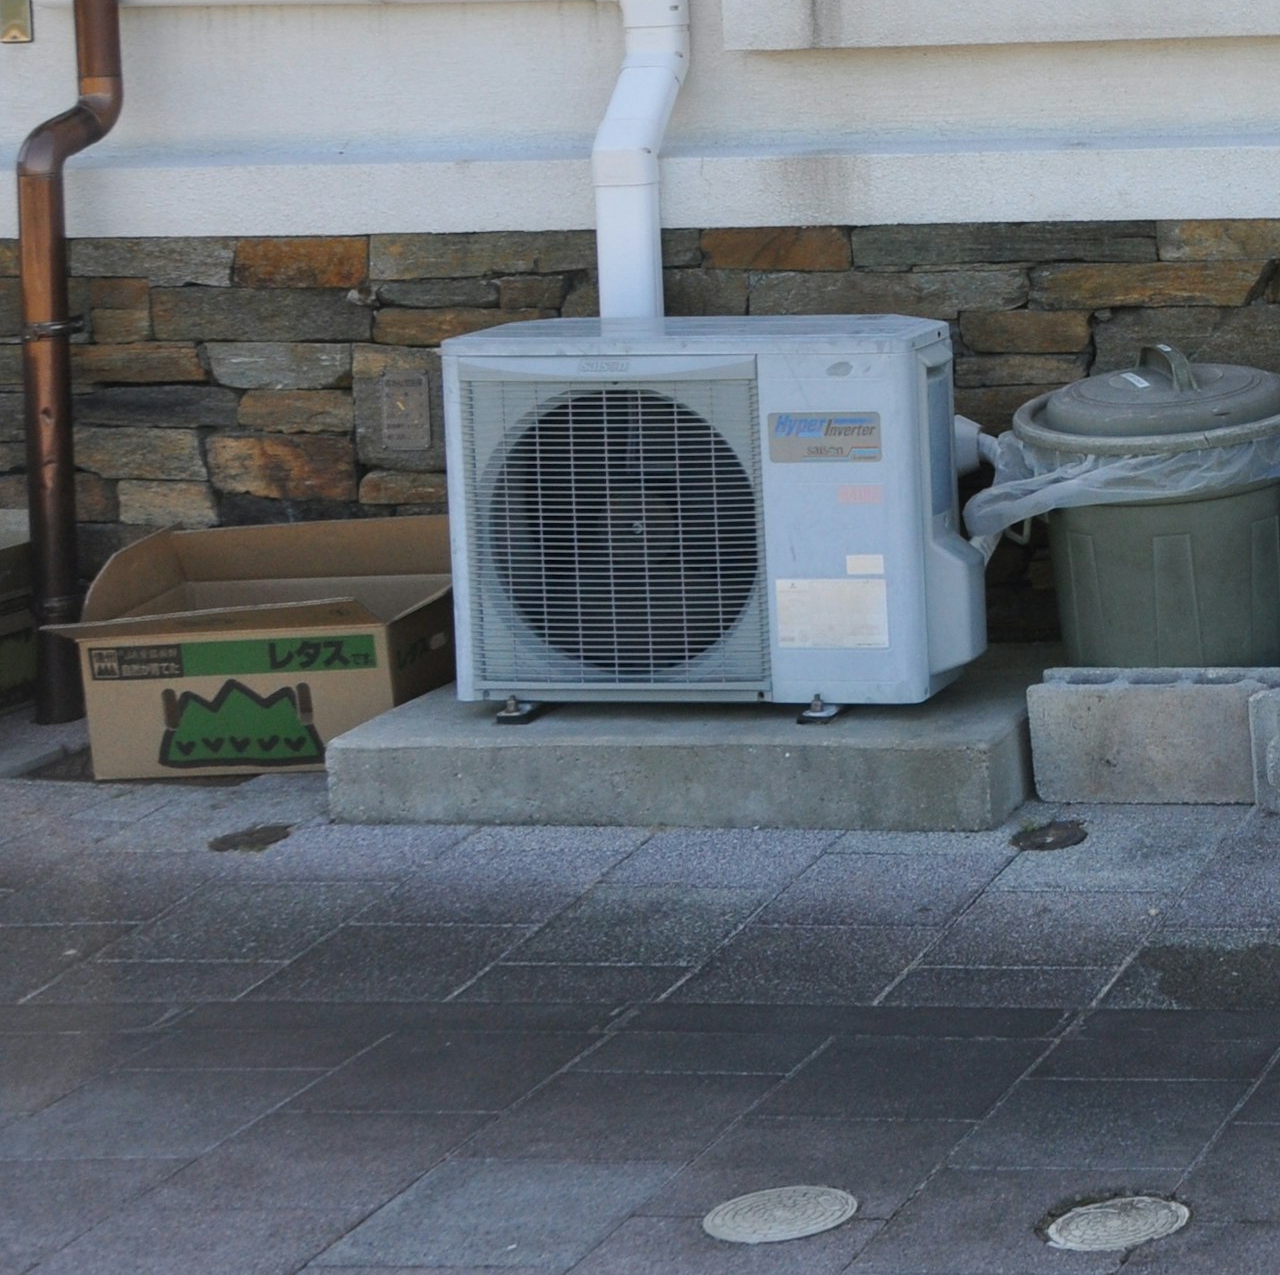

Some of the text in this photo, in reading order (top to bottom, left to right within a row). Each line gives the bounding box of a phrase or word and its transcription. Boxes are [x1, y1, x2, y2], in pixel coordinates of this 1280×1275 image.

[774, 414, 876, 437] Hyper Inverter
[807, 445, 844, 456] saison
